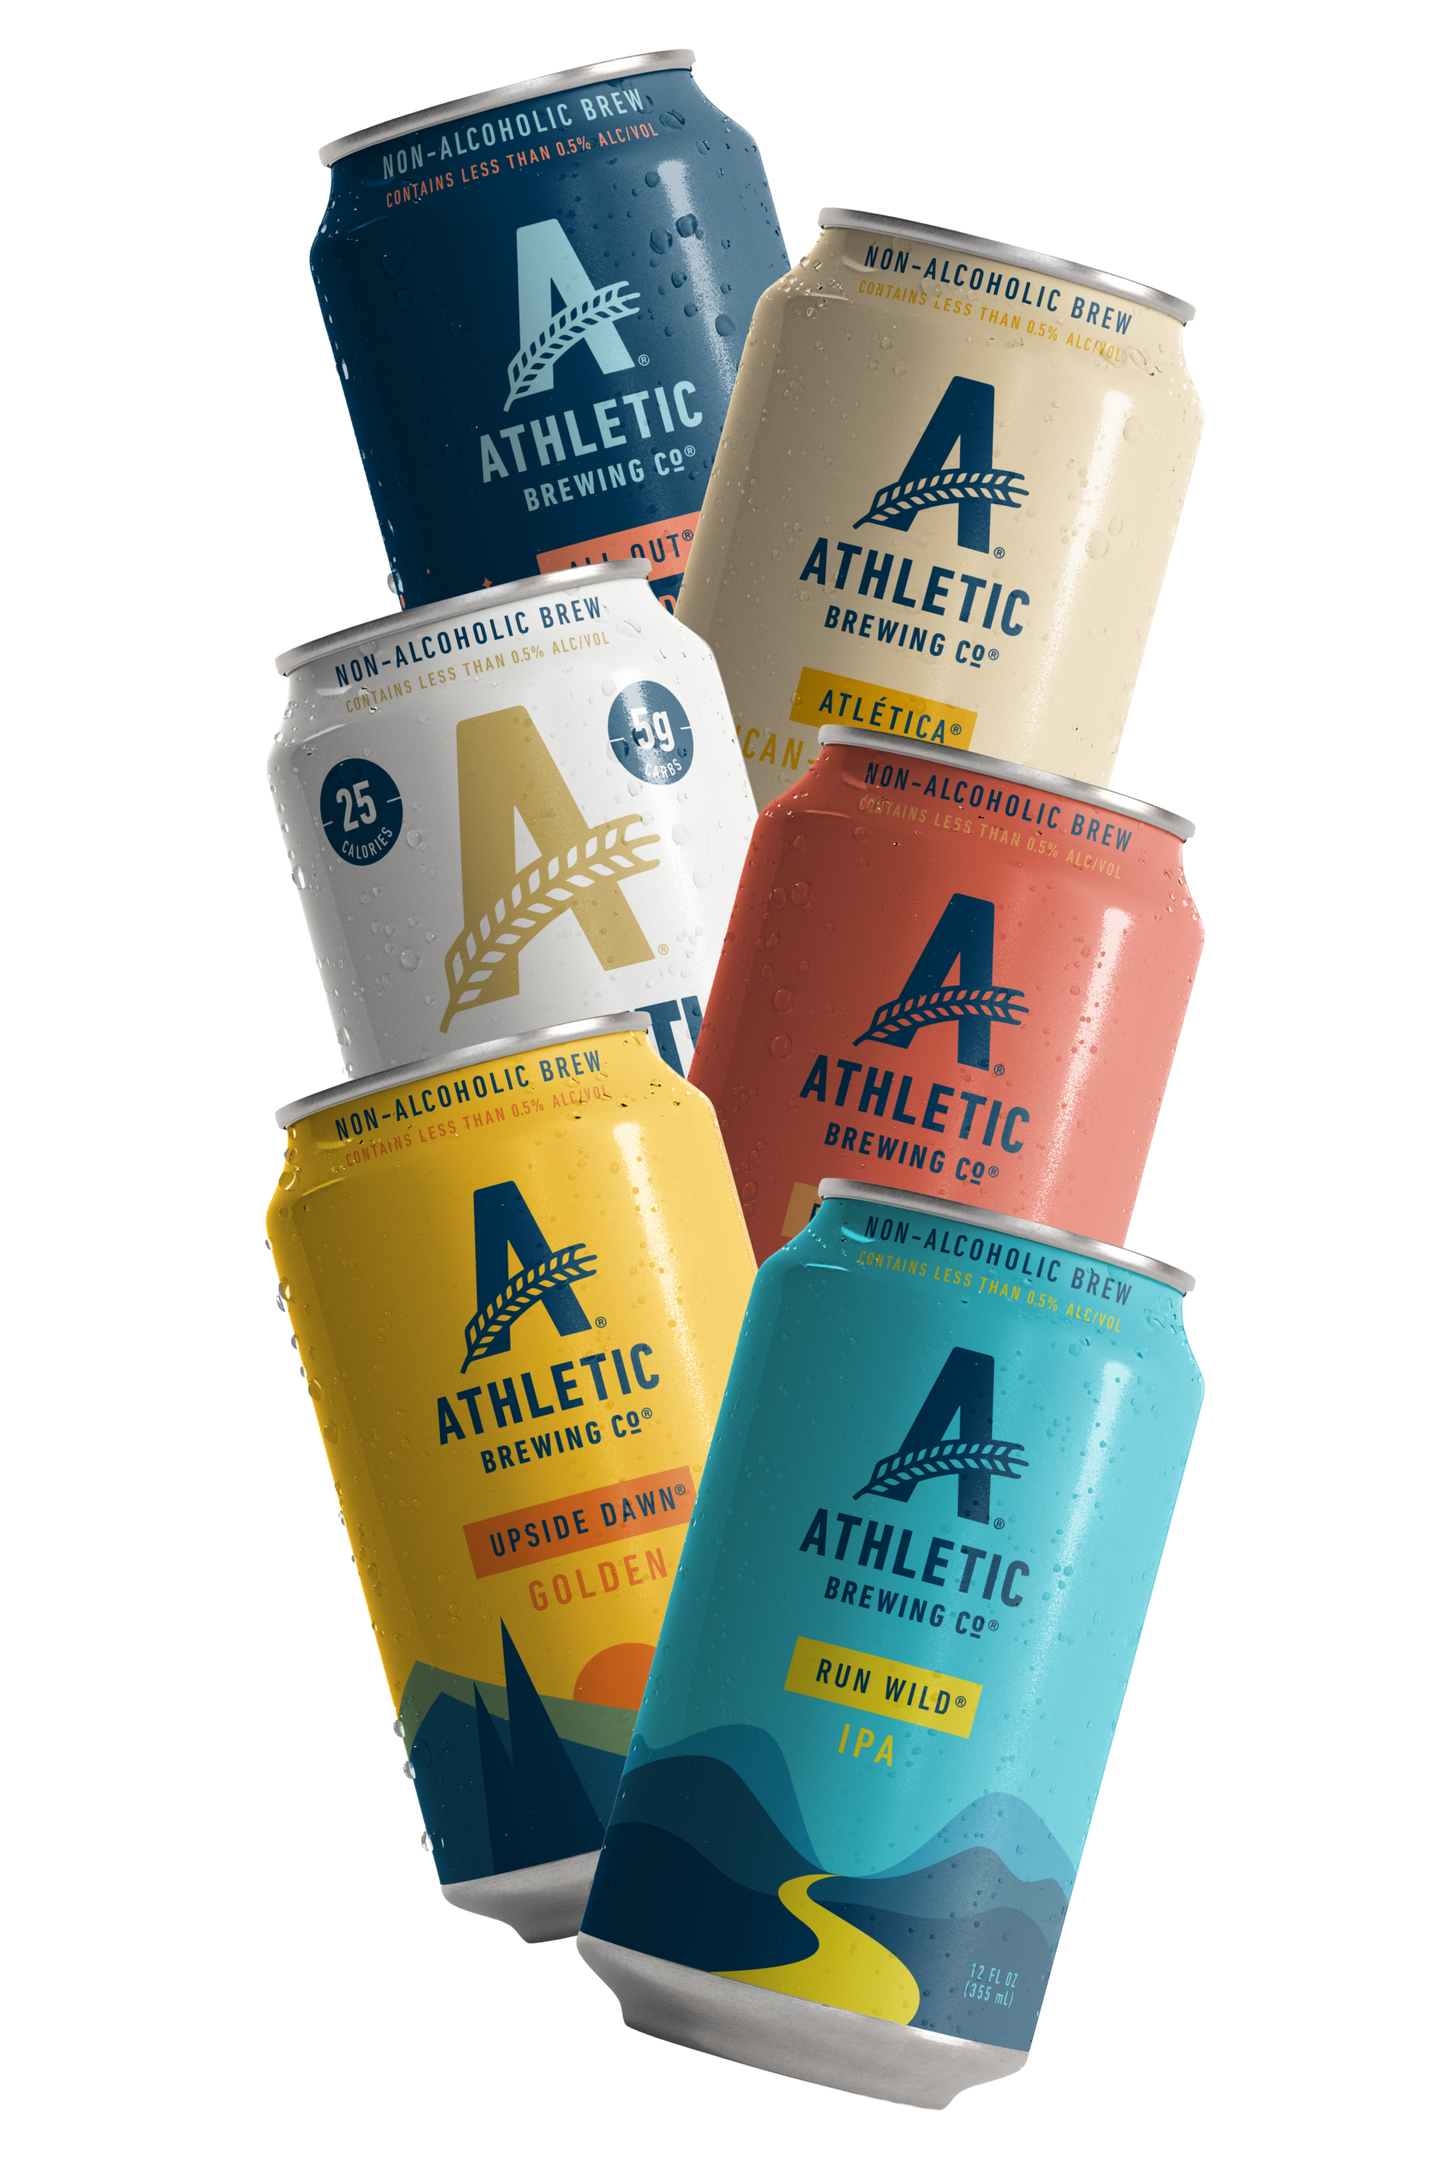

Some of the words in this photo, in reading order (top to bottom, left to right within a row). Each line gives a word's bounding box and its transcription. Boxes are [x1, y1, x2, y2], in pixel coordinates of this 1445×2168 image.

[382, 103, 573, 180] NON-ALCOHOLIC
[580, 88, 645, 121] BREW
[386, 172, 454, 208] CONTAINS
[461, 159, 500, 183] LESS
[506, 145, 551, 169] THAN
[556, 135, 591, 156] 0.5%
[598, 122, 659, 147] ALC/VOL
[858, 280, 928, 306] CONTAINS
[934, 295, 972, 317] LESS
[979, 306, 1021, 330] THAN
[1026, 319, 1059, 342] 0.5%
[1065, 332, 1121, 362] ALC/VOL
[864, 245, 1061, 311] NON-ALCOHOLIC
[1070, 296, 1133, 335] BREW
[479, 380, 703, 484] ATHLETIC
[523, 458, 645, 512] BREWING
[799, 536, 1031, 637] ATHLETIC
[335, 611, 529, 687] NON-ALCOHOLIC
[539, 596, 601, 628] BREW
[345, 680, 413, 713] CONTAINS
[418, 666, 457, 689] LESS
[462, 653, 506, 677] THAN
[511, 644, 544, 664] 0.5%
[552, 631, 610, 655] ALC/VOL
[824, 605, 945, 657] BREWING
[630, 707, 675, 752] 5g
[645, 758, 682, 779] CARBS
[336, 780, 377, 832] 25
[342, 826, 393, 860] CALORIES
[858, 797, 928, 823] CONTAINS
[934, 812, 972, 834] LESS
[979, 823, 1021, 847] THAN
[1026, 836, 1059, 859] 0.5%
[1065, 849, 1121, 879] ALC/VOL
[864, 762, 1061, 828] NON-ALCOHOLIC
[1070, 813, 1133, 852] BREW
[335, 1065, 529, 1141] NON-ALCOHOLIC
[539, 1050, 601, 1082] BREW
[345, 1134, 413, 1167] CONTAINS
[418, 1120, 457, 1143] LESS
[462, 1107, 506, 1131] THAN
[511, 1098, 544, 1118] 0.5%
[552, 1085, 610, 1109] ALC/VOL
[799, 1053, 1031, 1154] ATHLETIC
[824, 1122, 945, 1174] BREWING
[858, 1250, 928, 1276] CONTAINS
[934, 1265, 972, 1287] LESS
[979, 1276, 1021, 1300] THAN
[1026, 1289, 1059, 1312] 0.5%
[1065, 1302, 1121, 1332] ALC/VOL
[864, 1215, 1061, 1281] NON-ALCOHOLIC
[1070, 1266, 1133, 1305] BREW
[436, 1342, 660, 1445] ATHLETIC
[480, 1421, 602, 1474] BREWING
[489, 1507, 590, 1557] UPSIDE
[799, 1506, 1031, 1607] ATHLETIC
[528, 1548, 668, 1612] GOLDEN
[824, 1575, 945, 1627] BREWING
[815, 1658, 871, 1694] RUN
[838, 1723, 895, 1767] IPA
[963, 1981, 992, 2001] (355
[994, 1991, 1014, 2008] mL)
[970, 1963, 985, 1980] 12
[988, 1967, 1001, 1984] FL
[1005, 1972, 1018, 1988] OZ
